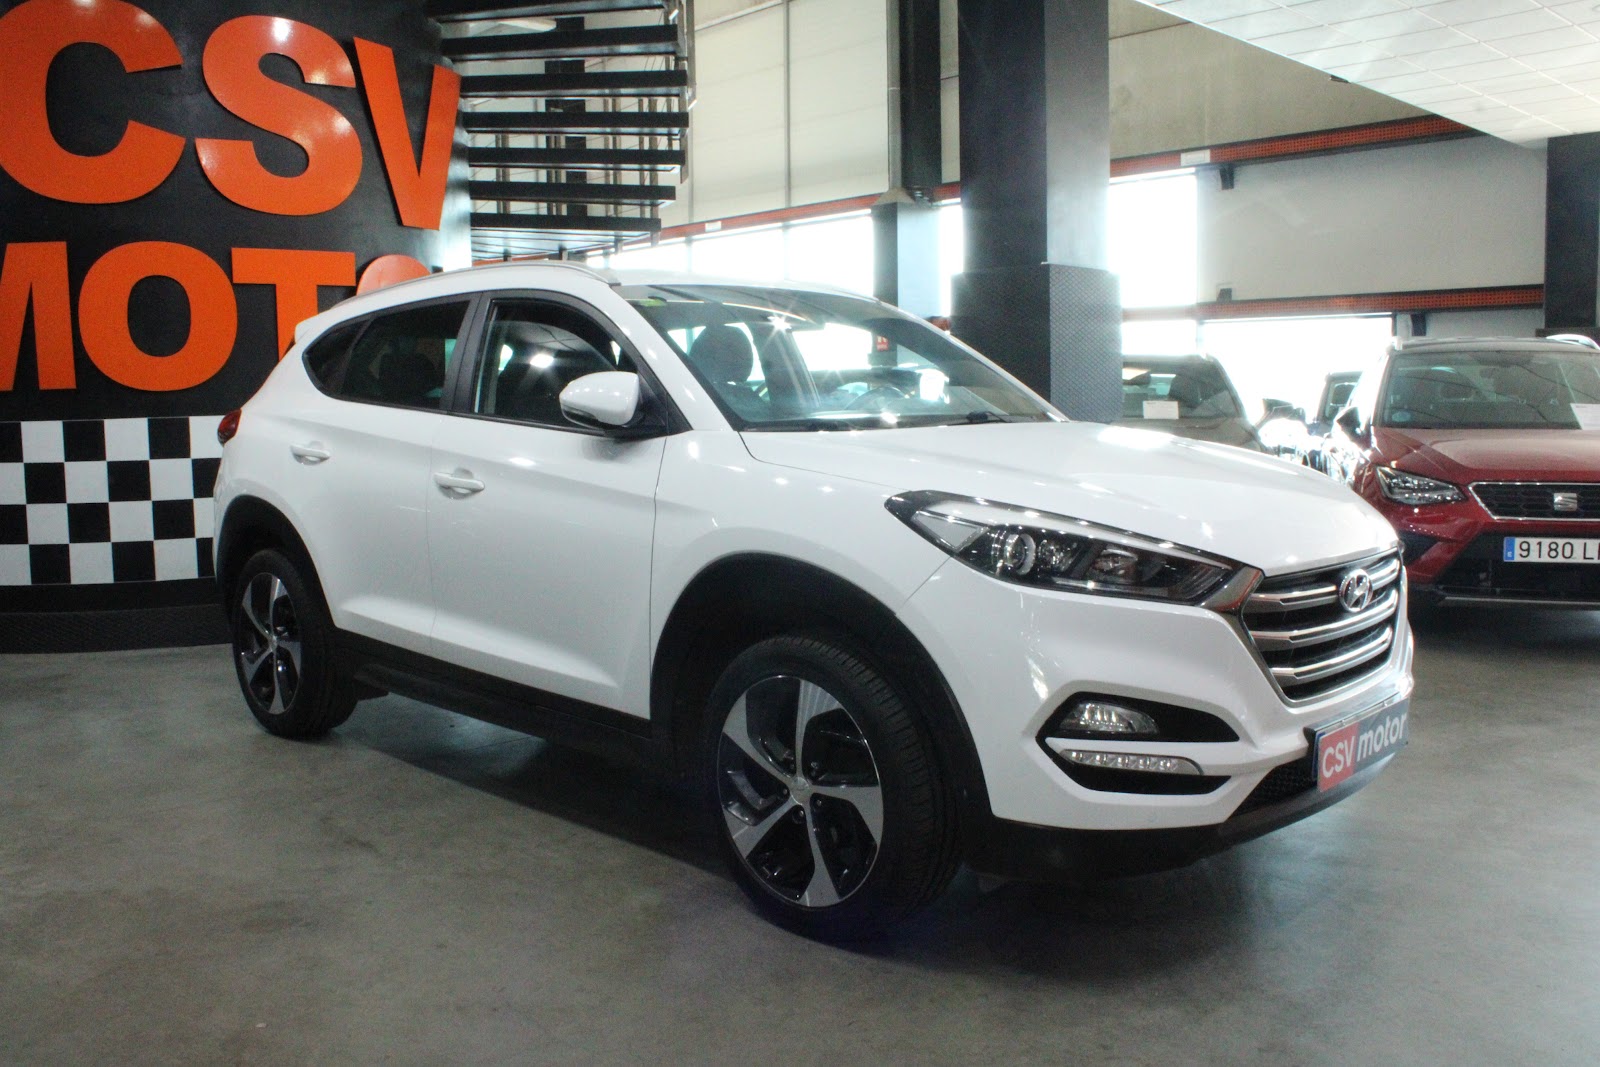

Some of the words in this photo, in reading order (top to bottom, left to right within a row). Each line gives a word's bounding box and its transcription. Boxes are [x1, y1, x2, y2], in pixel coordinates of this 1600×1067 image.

[0, 0, 461, 230] CSV
[0, 241, 432, 391] OT
[1519, 541, 1574, 559] 9180
[1583, 542, 1600, 560] L
[1322, 736, 1356, 778] CSV
[1357, 713, 1407, 762] motor
